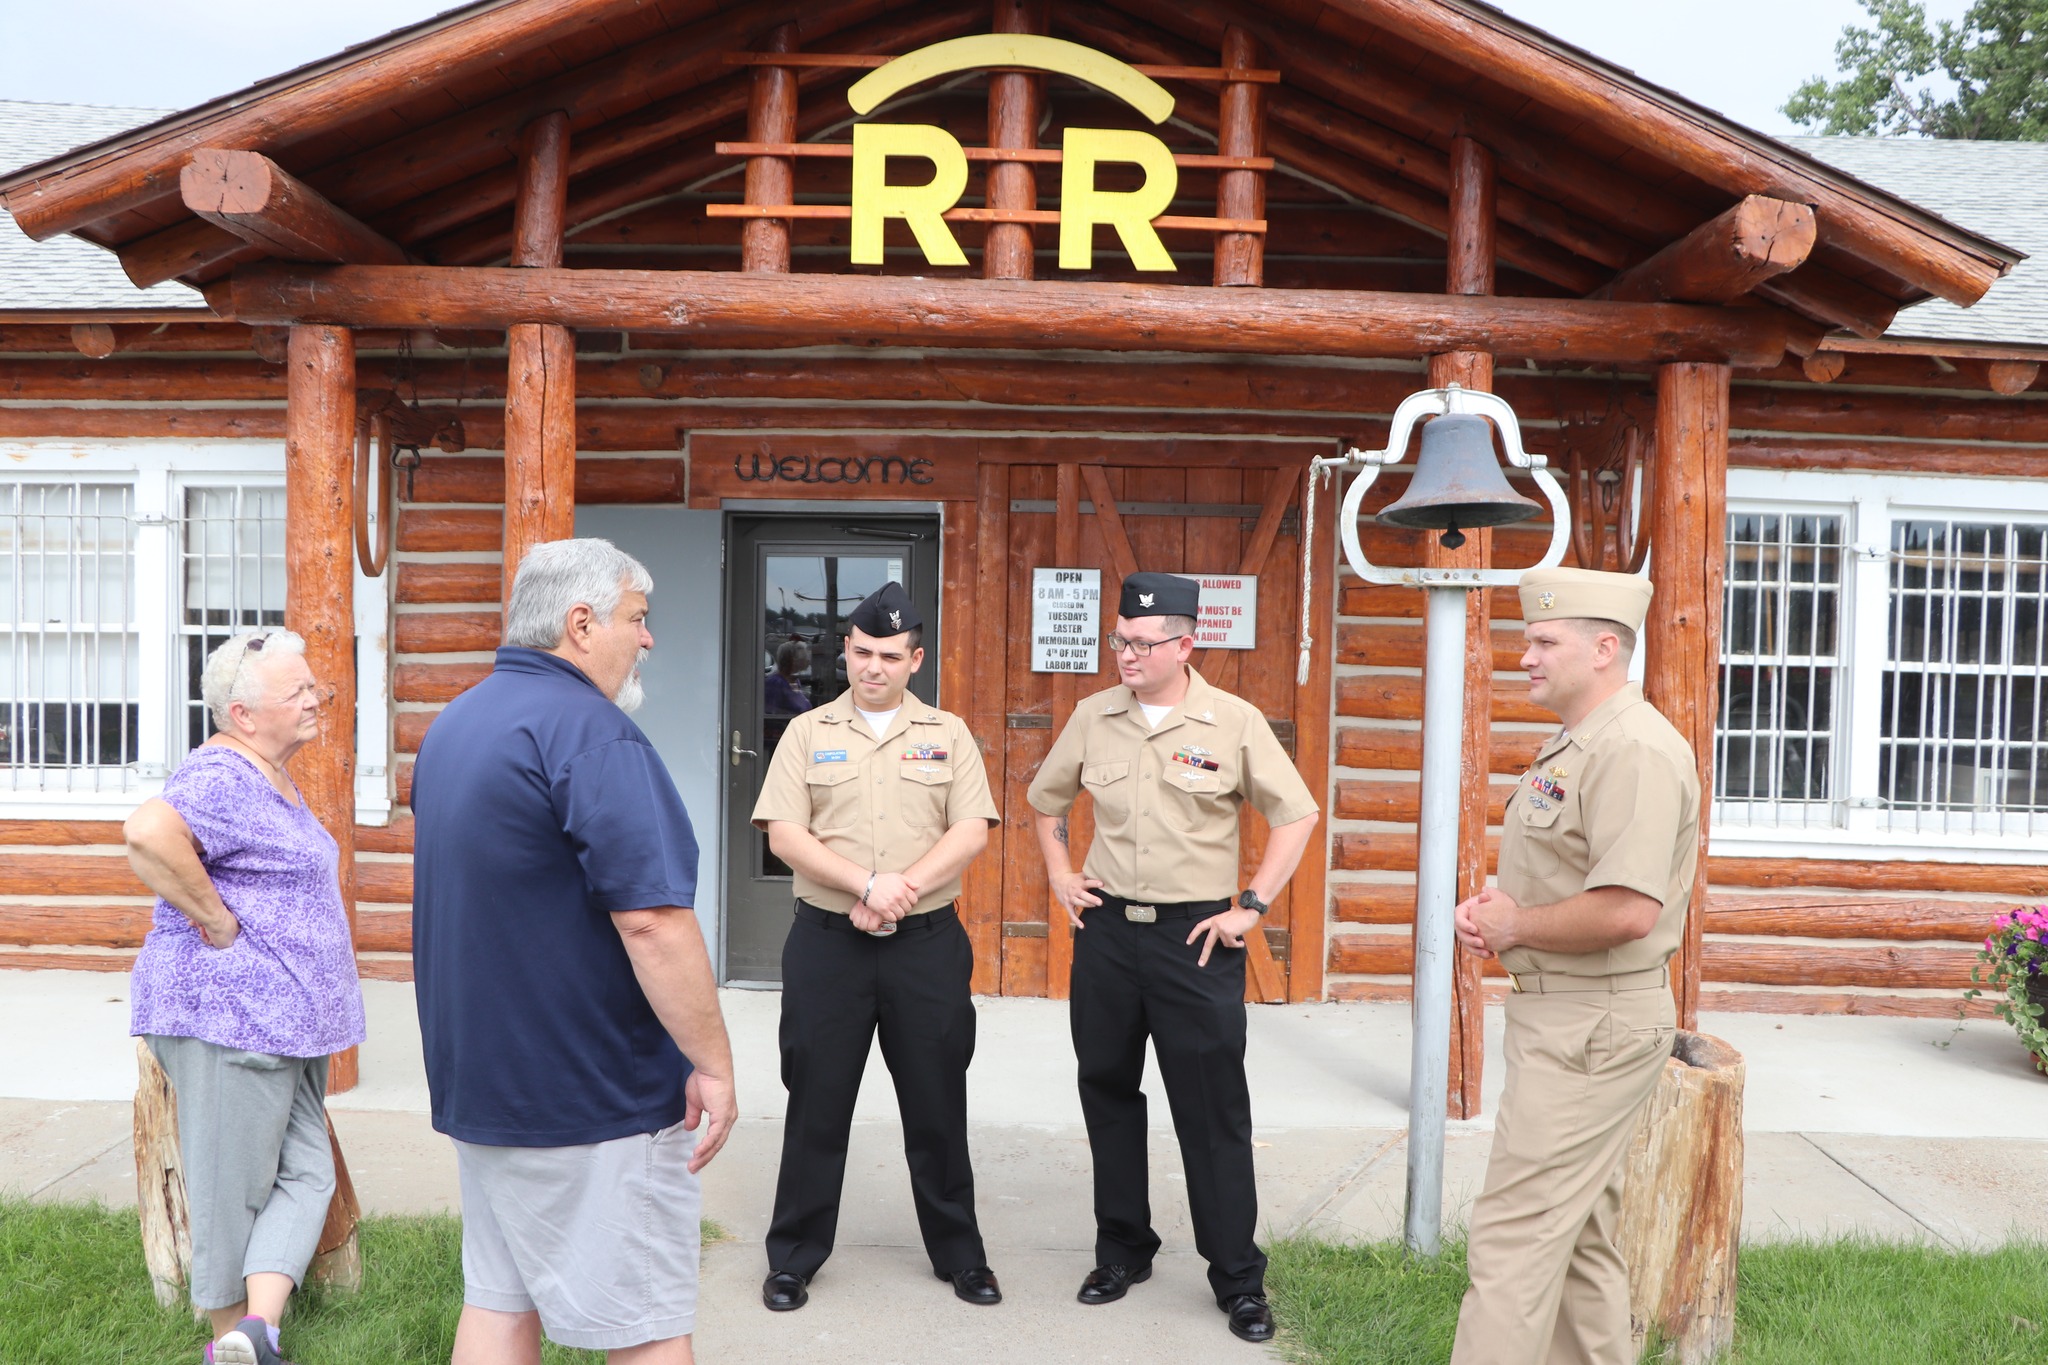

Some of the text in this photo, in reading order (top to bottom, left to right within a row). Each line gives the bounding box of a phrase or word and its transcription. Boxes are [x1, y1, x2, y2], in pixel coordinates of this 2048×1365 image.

[734, 453, 934, 484] WELCOME
[1055, 571, 1082, 583] OPEN
[1202, 579, 1242, 589] ALLOWED
[1038, 587, 1045, 599] 8
[1047, 588, 1064, 600] AM
[1072, 588, 1080, 600] 5
[1082, 588, 1099, 601] PM
[1052, 601, 1075, 609] CLOSED
[1047, 611, 1088, 621] TUESDAYS
[1205, 606, 1230, 616] MUST
[1231, 606, 1242, 616] BE
[1053, 623, 1082, 633] EASTER
[1196, 618, 1232, 629] MPANIED
[1037, 635, 1097, 646] MEMORIAL DAY
[1201, 632, 1228, 642] ADULT
[1046, 648, 1088, 658] 4TH OF JULY
[1045, 660, 1088, 670] LABOR DAY
